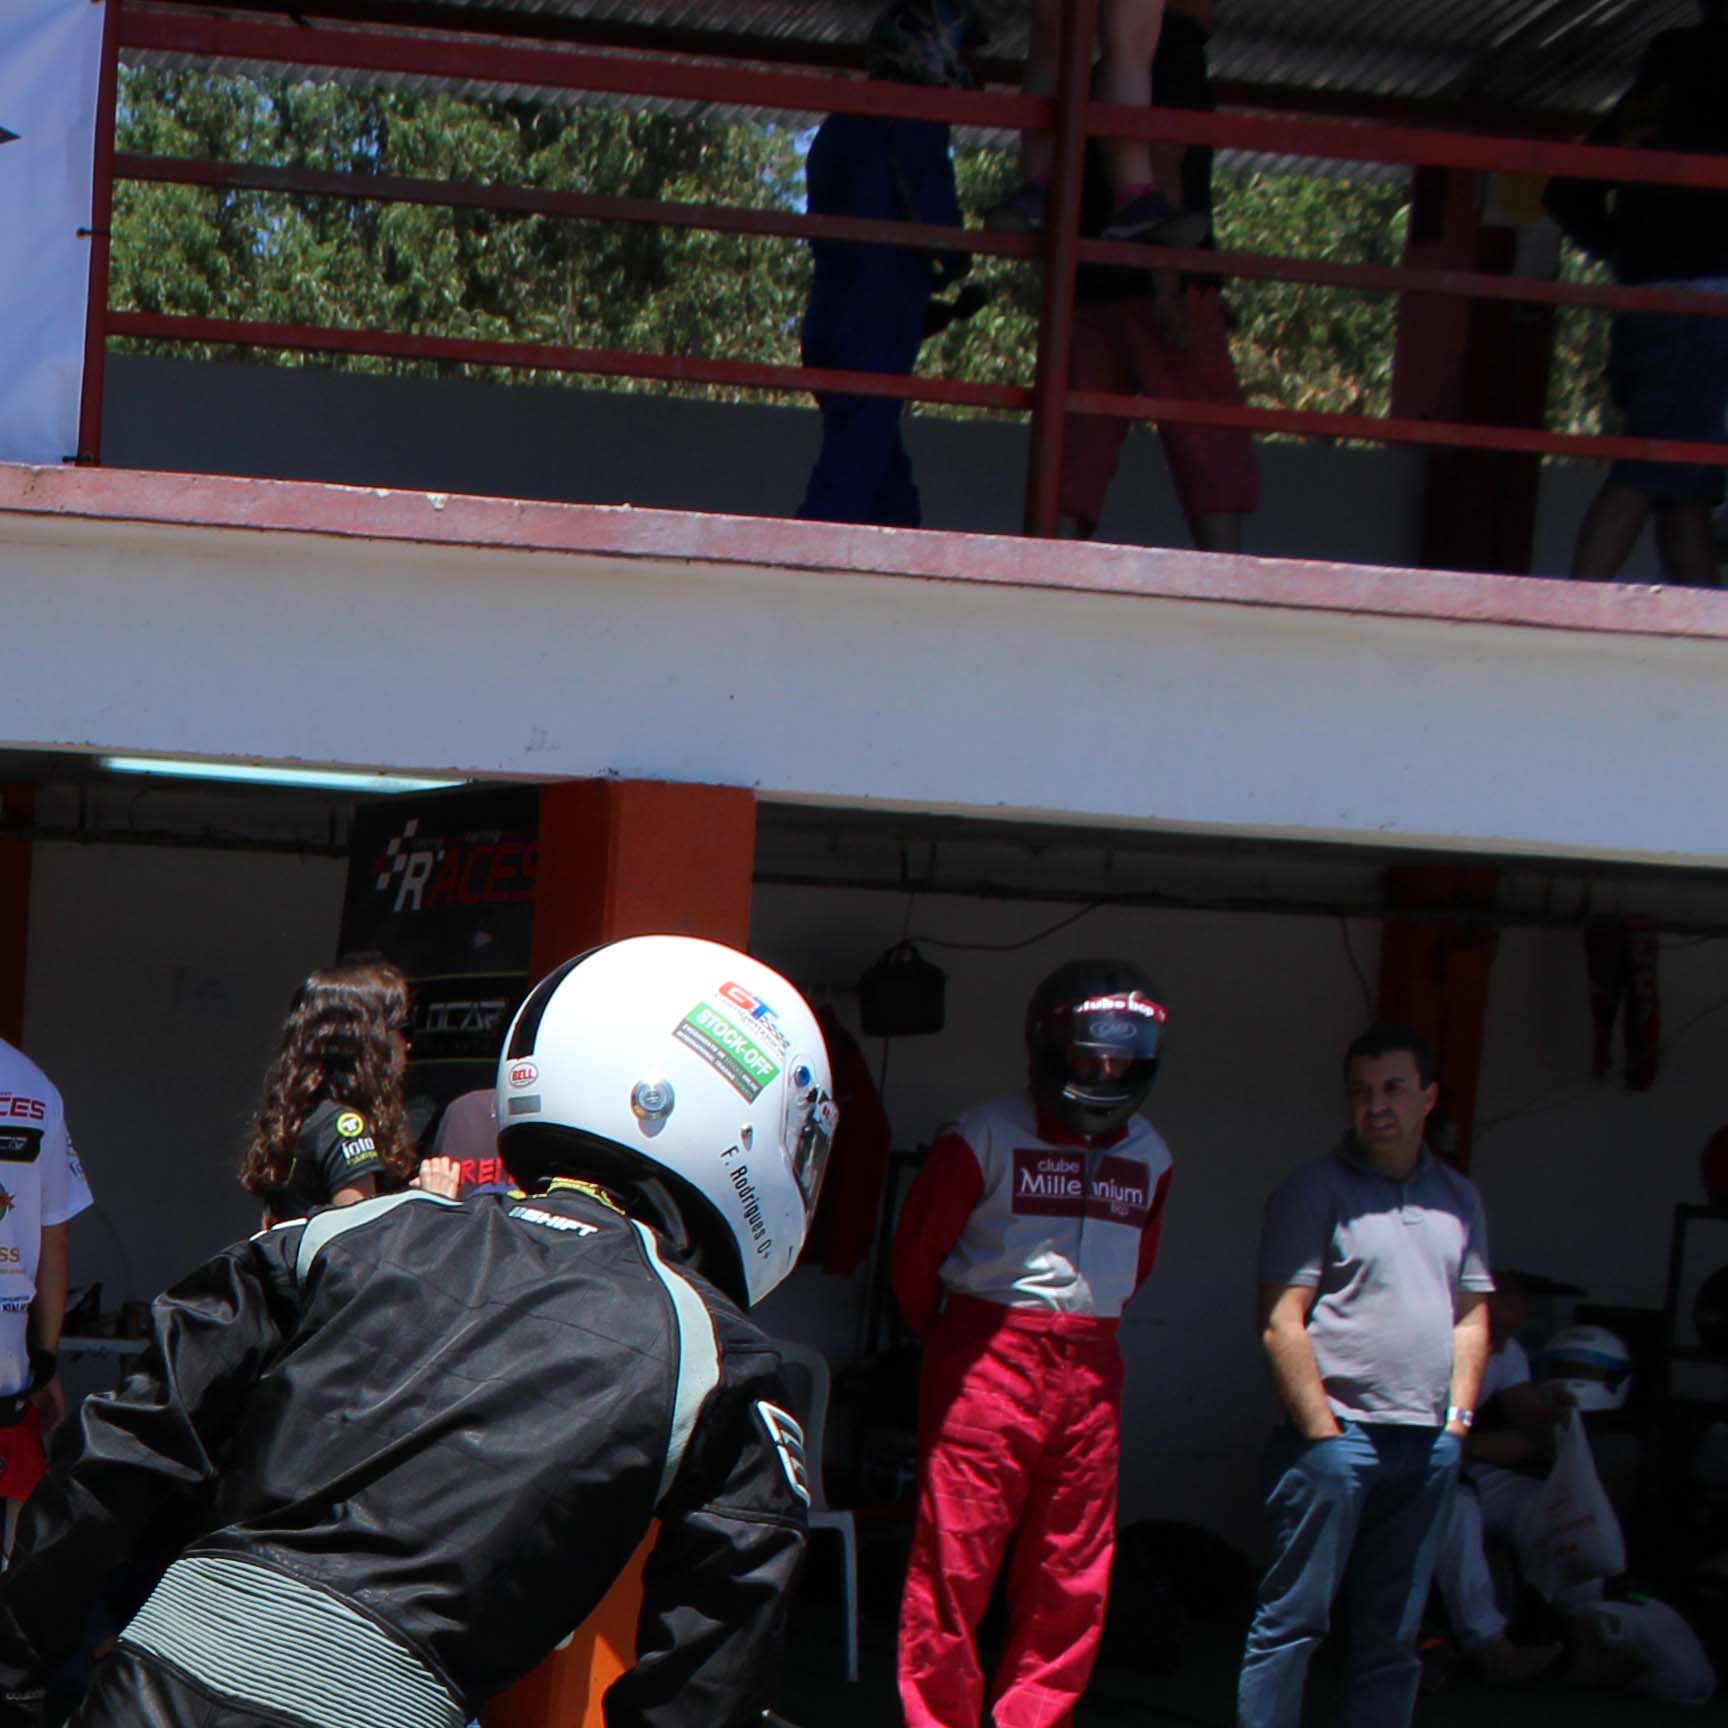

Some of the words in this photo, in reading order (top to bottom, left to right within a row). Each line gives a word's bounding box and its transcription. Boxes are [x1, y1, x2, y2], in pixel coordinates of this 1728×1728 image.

[694, 1009, 775, 1078] STOCK-OFF
[510, 1068, 535, 1082] BELL
[1037, 1158, 1081, 1173] clube
[730, 1165, 765, 1240] Rodrigues
[520, 1208, 599, 1238] SHIFT
